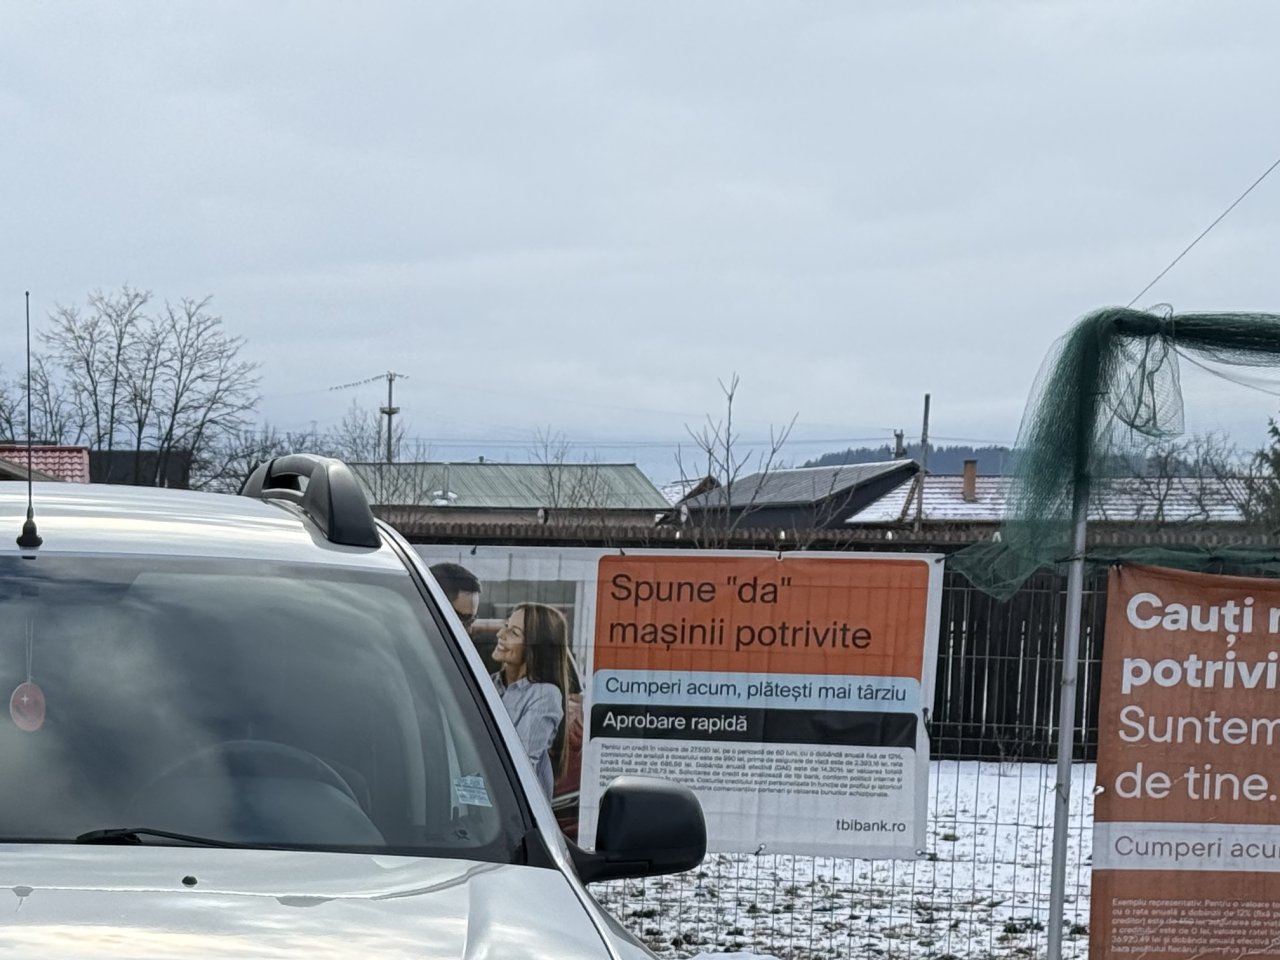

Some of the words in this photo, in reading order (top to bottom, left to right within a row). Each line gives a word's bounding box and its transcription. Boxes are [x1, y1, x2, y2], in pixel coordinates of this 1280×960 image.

[610, 573, 716, 607] Spune
[726, 575, 792, 604] "da"
[608, 617, 725, 651] mașinii
[735, 619, 872, 652] potrivite
[1126, 592, 1253, 649] Cauți
[605, 677, 681, 697] Cumperi
[686, 684, 741, 698] acum,
[746, 680, 812, 702] plătești
[818, 684, 852, 699] mai
[856, 683, 907, 701] târziu
[602, 711, 686, 732] Aprobare
[691, 713, 747, 735] rapidă
[1118, 705, 1280, 745] Suntem
[1114, 762, 1171, 800] de
[1184, 764, 1277, 801] tine.
[836, 818, 906, 833] tbibank.ro
[1114, 836, 1221, 863] Cumperi
